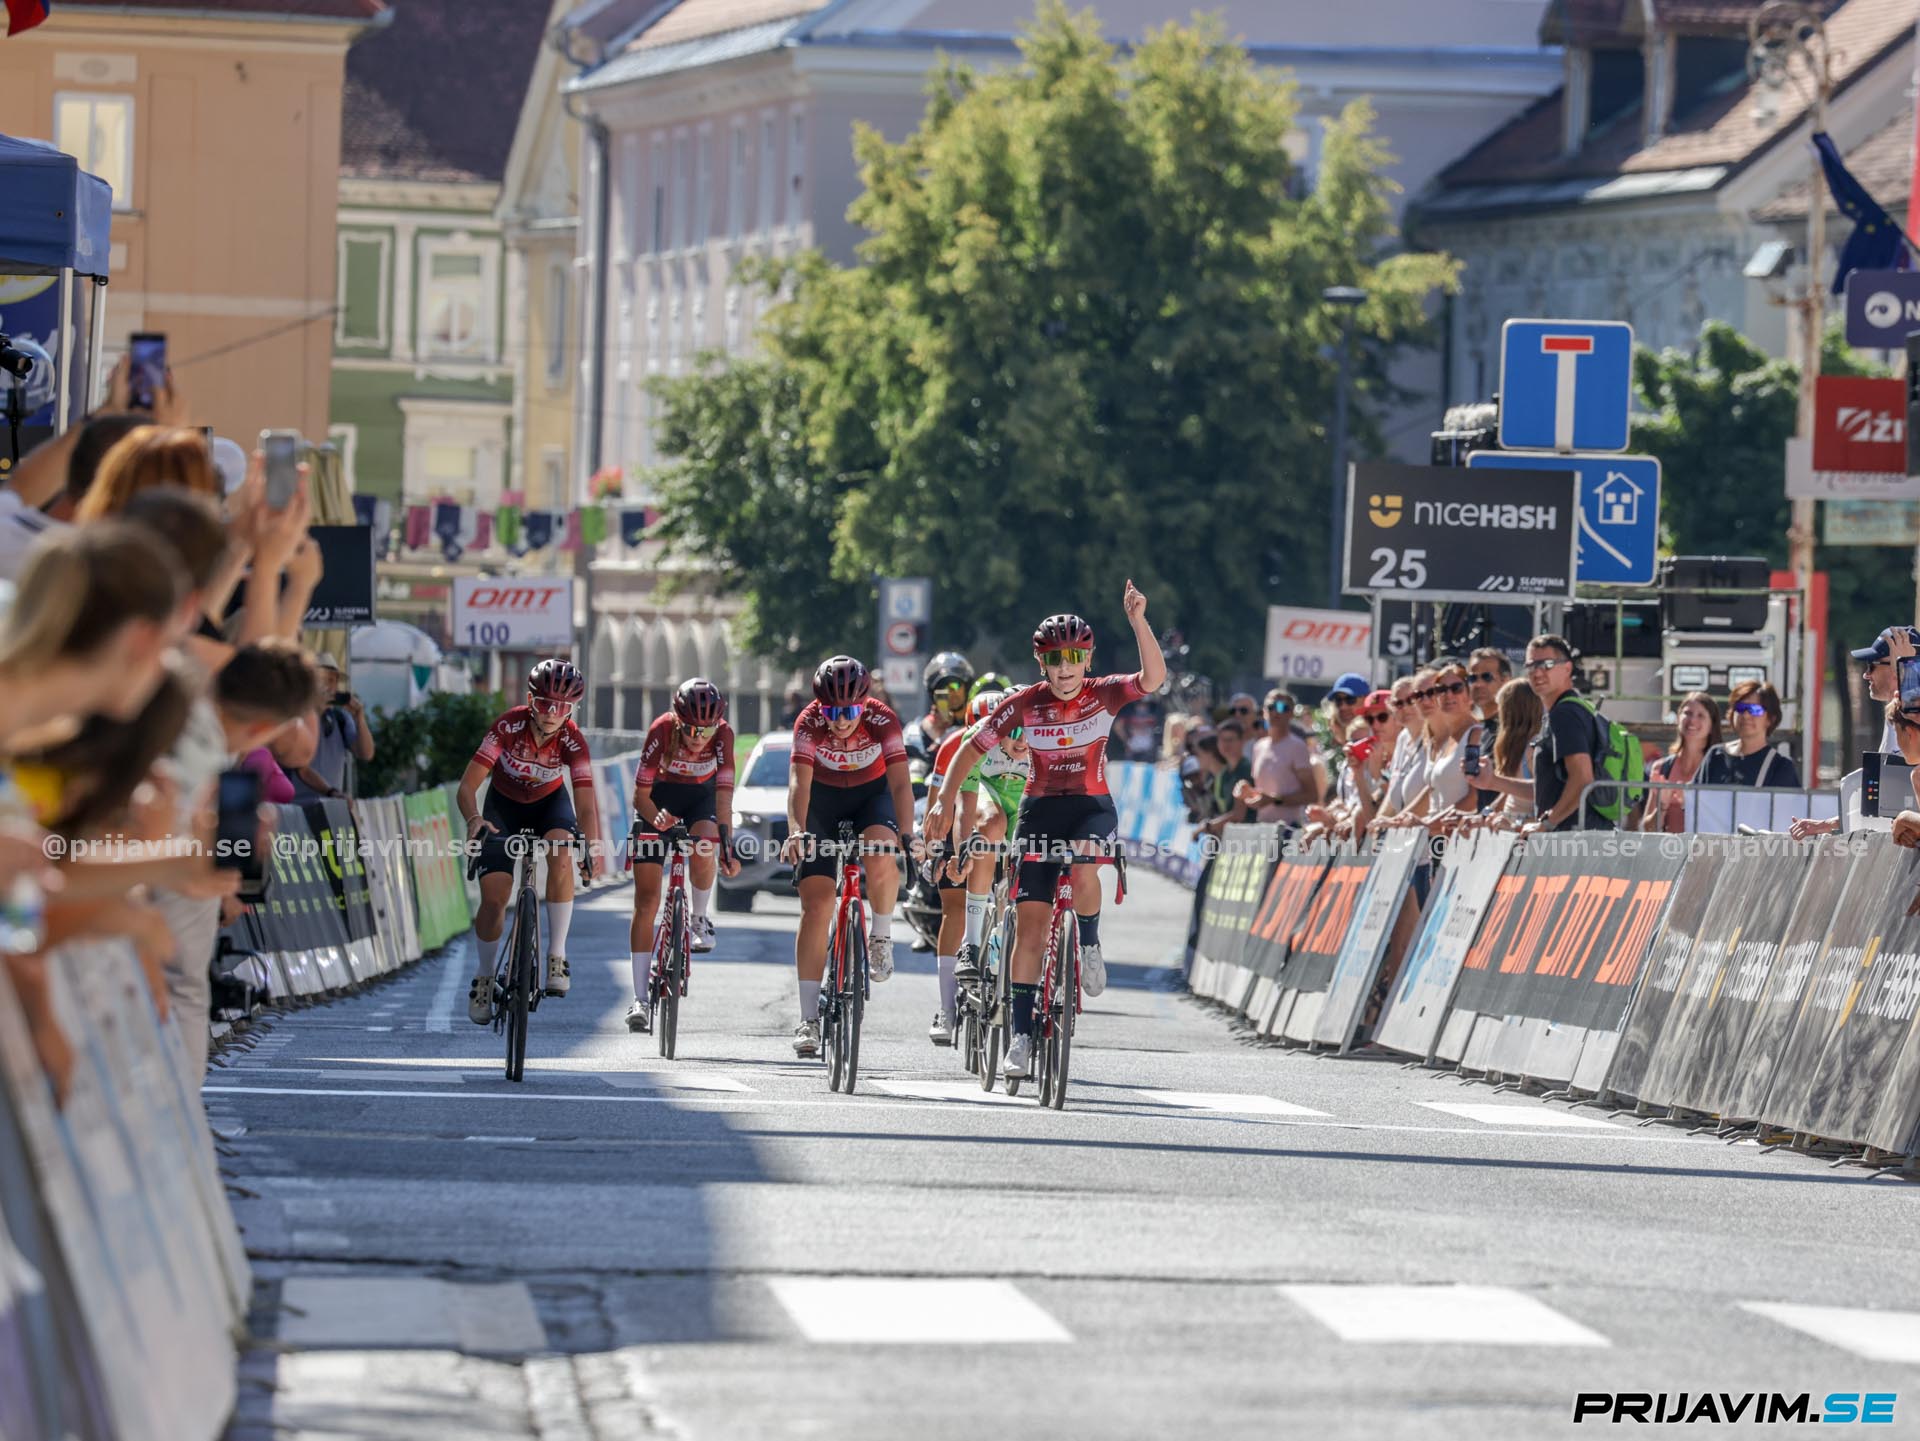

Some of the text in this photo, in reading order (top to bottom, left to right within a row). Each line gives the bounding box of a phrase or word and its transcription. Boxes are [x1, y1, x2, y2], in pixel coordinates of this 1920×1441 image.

[1367, 547, 1428, 589] 25
[1520, 576, 1565, 587] SLOVENIA
[465, 586, 566, 609] DMT
[466, 621, 511, 645] 100
[1281, 618, 1372, 648] DMT
[1280, 653, 1324, 679] 100
[1533, 875, 1631, 980] DMT
